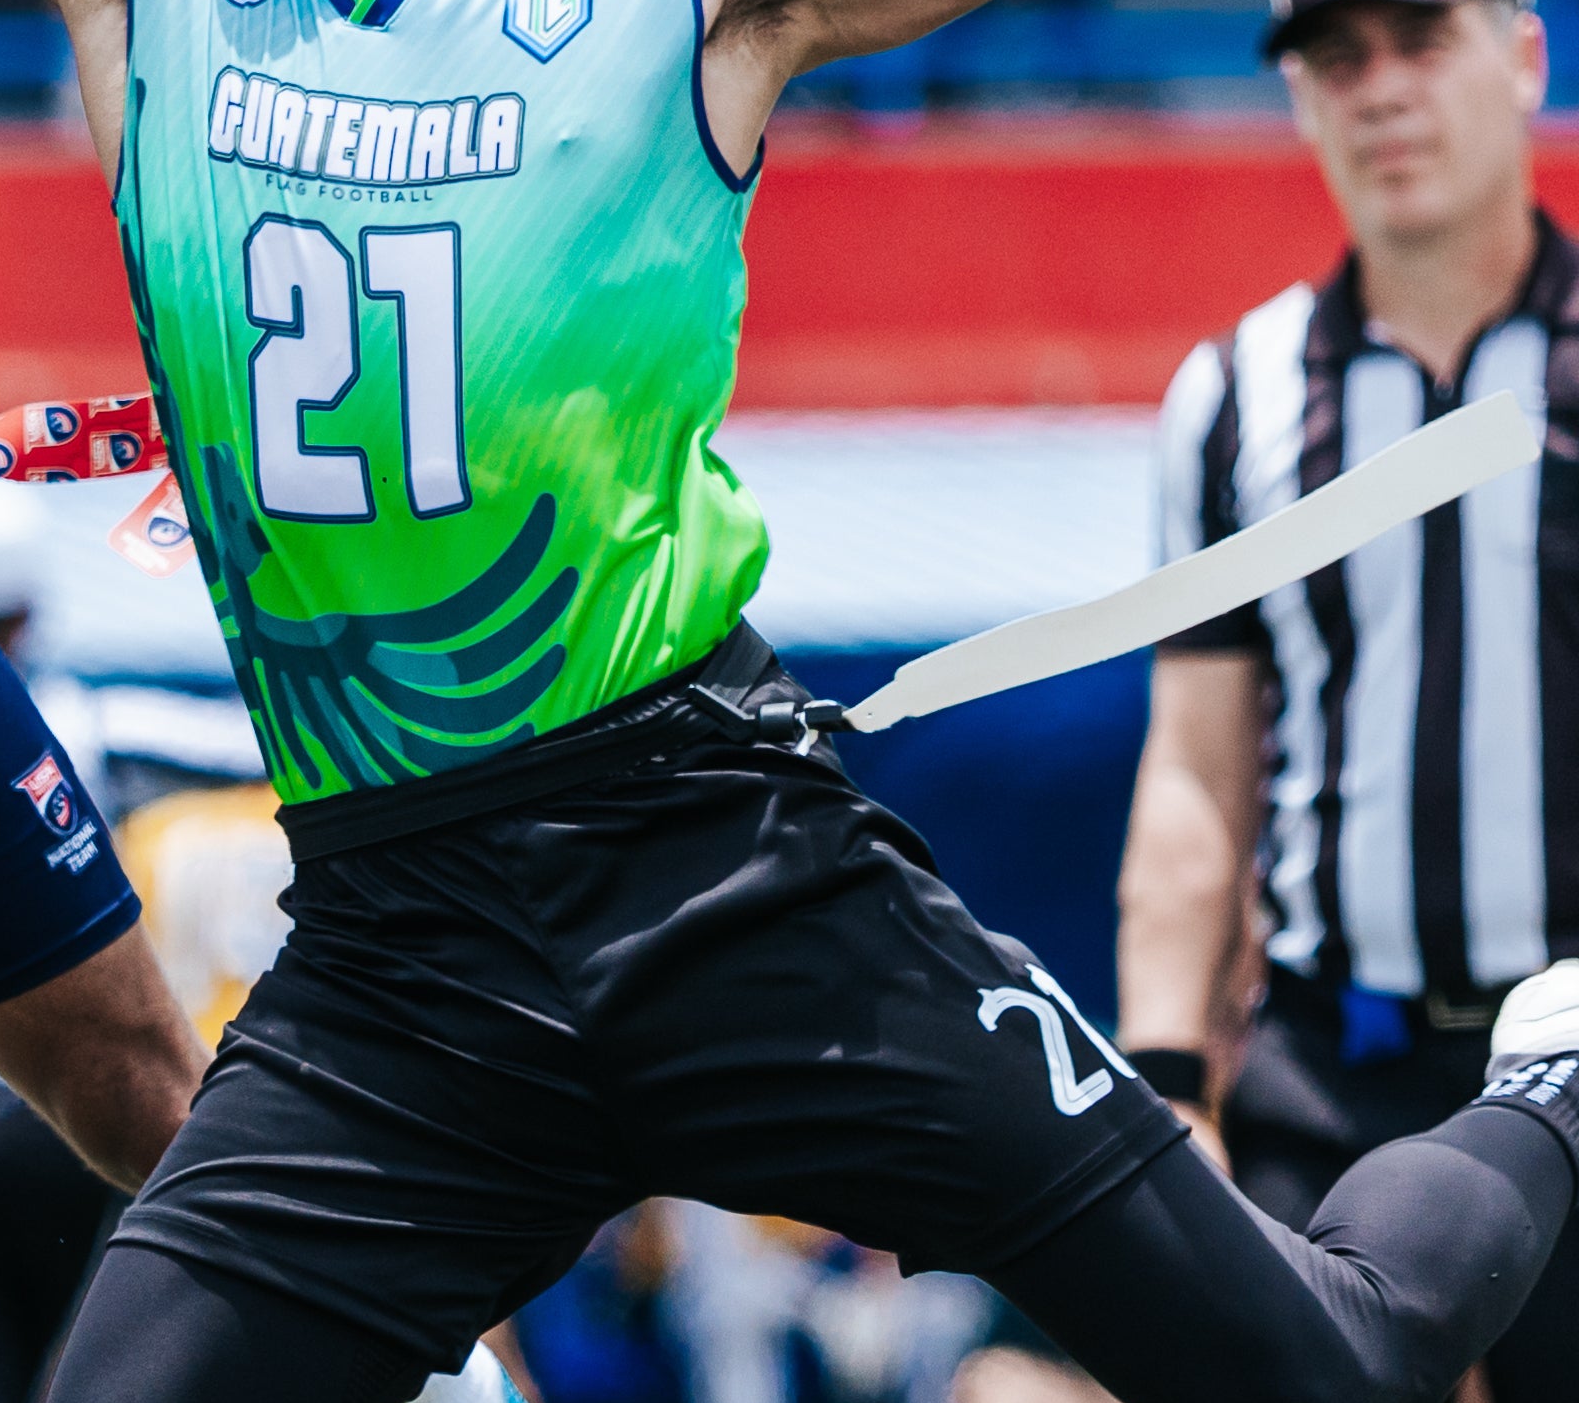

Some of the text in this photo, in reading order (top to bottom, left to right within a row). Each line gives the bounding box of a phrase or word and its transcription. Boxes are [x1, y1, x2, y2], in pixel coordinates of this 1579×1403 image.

[209, 66, 525, 187] GUATEMALA
[319, 184, 433, 203] FOOTBALL
[243, 213, 472, 523] 21
[66, 840, 99, 873] TEAM
